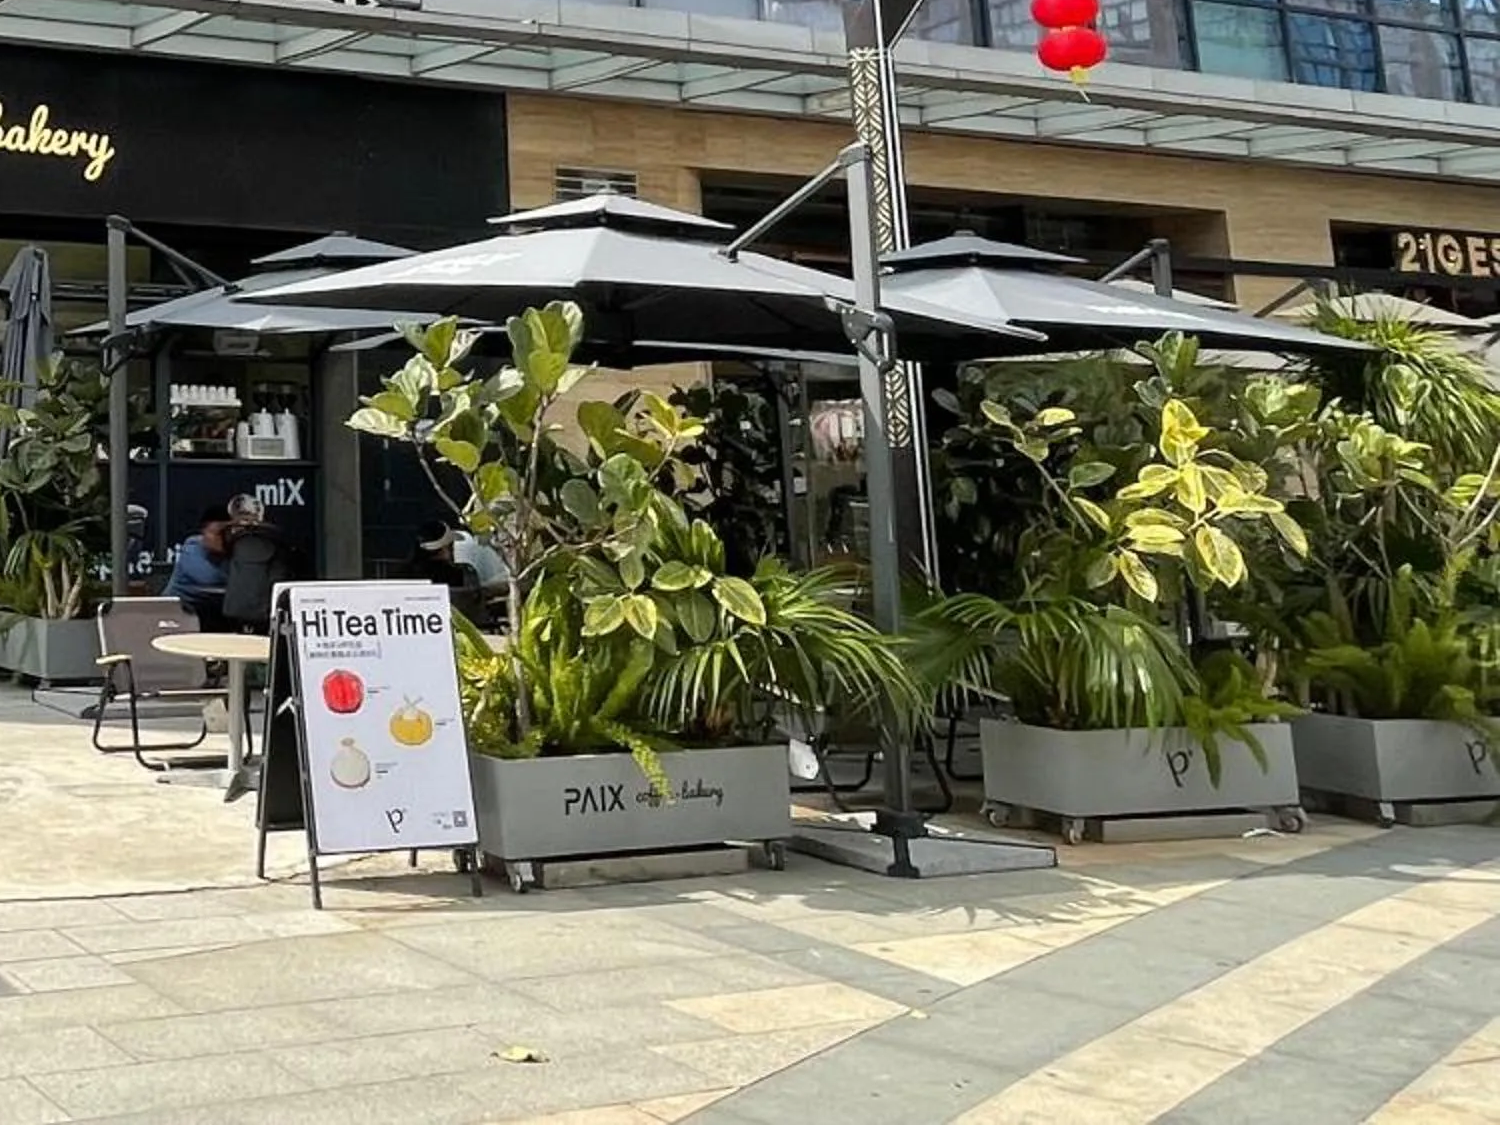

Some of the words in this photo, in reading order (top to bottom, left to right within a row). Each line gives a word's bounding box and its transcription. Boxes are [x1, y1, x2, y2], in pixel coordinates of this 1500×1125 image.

[301, 608, 328, 637] Hi
[332, 610, 378, 637] Tea
[381, 606, 443, 636] Time
[564, 784, 626, 816] PAIX
